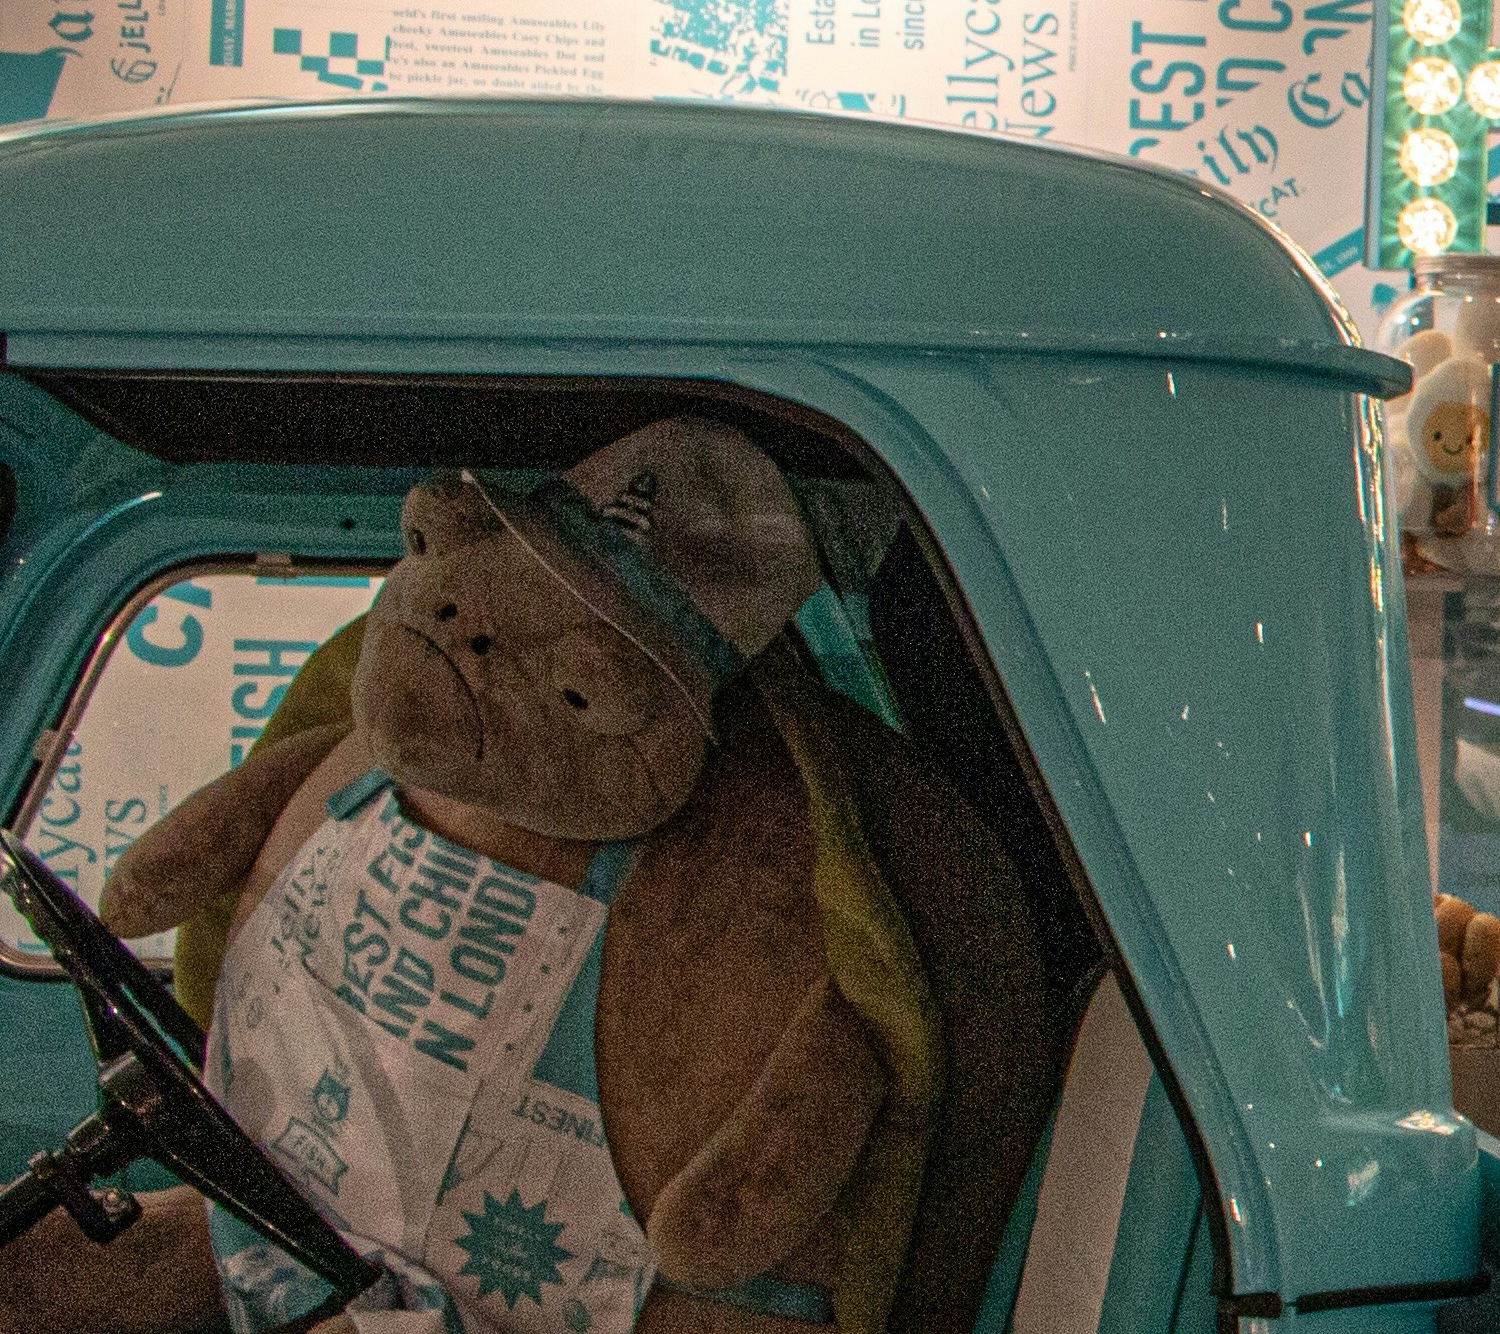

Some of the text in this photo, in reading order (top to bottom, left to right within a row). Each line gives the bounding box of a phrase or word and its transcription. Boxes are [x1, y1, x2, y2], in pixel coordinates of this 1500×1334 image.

[460, 14, 505, 26] smiling
[509, 17, 579, 30] Amuseables
[849, 25, 880, 49] in
